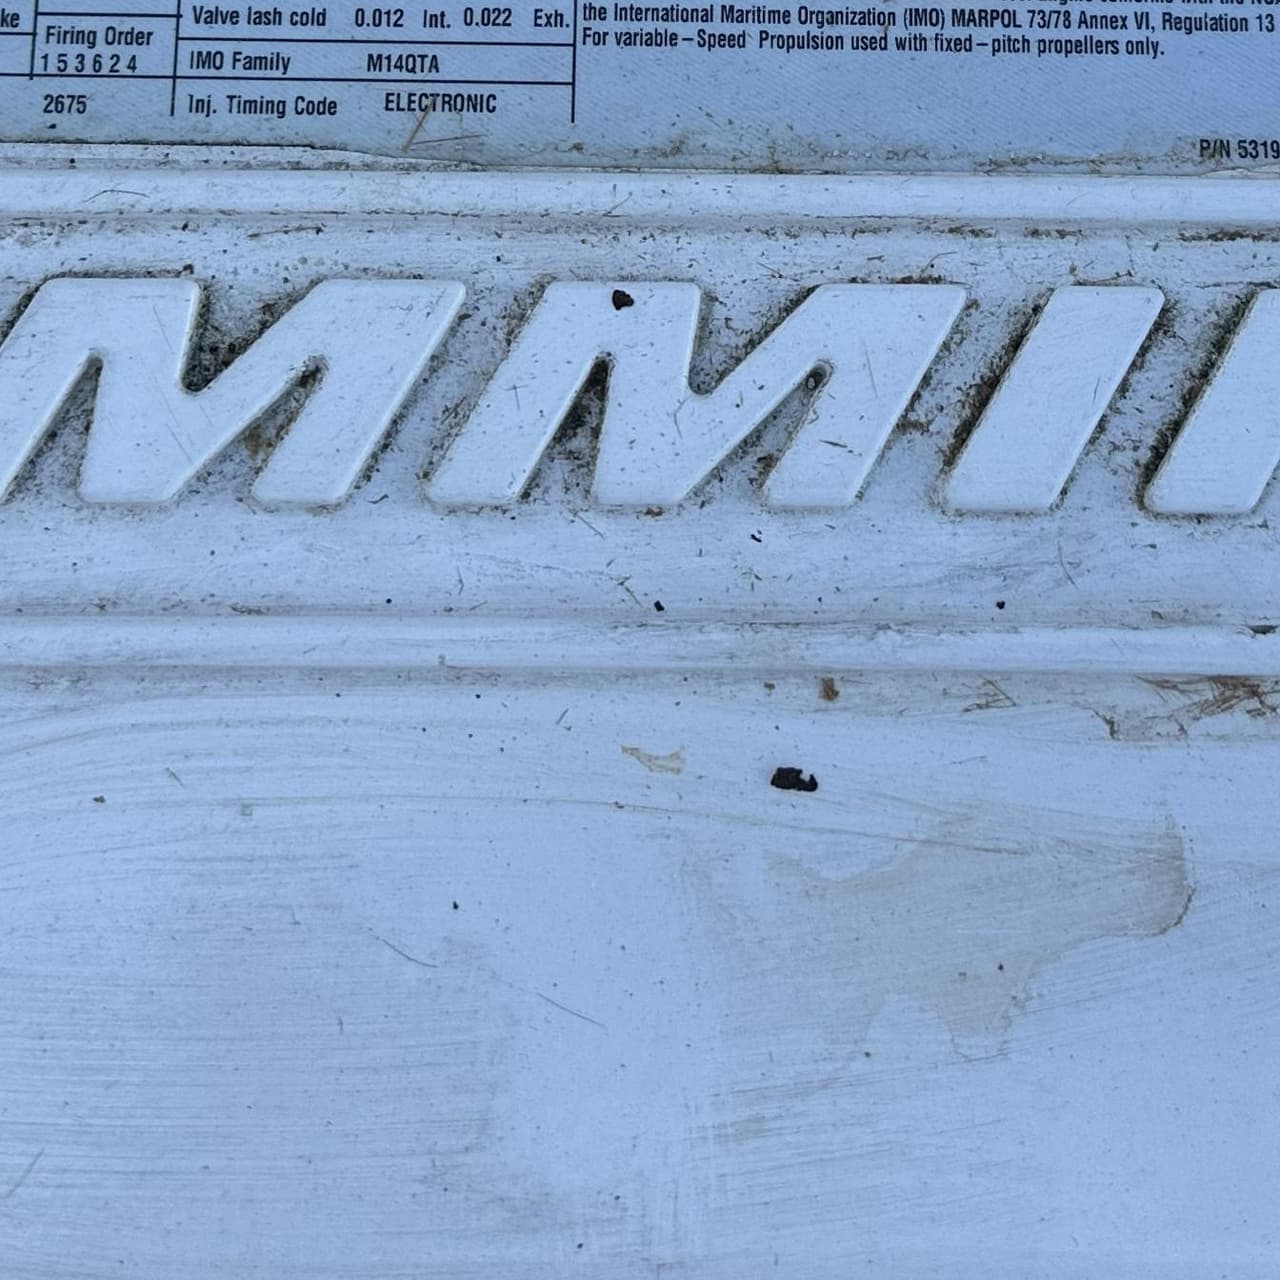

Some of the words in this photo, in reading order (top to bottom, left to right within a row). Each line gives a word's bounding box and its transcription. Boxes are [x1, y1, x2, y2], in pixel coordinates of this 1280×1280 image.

[192, 5, 240, 25] Valve
[247, 6, 282, 26] lash
[290, 7, 327, 27] cold
[355, 8, 404, 28] 0.012
[423, 9, 451, 29] Int.
[464, 7, 512, 27] 0.022
[534, 8, 570, 28] Exh.
[583, 2, 607, 21] the
[614, 3, 714, 23] International
[721, 4, 791, 24] Maritime
[952, 9, 1022, 28] MARPOL
[1027, 9, 1071, 29] 73/78
[1077, 10, 1128, 30] Annex
[1134, 11, 1155, 33] VI,
[1256, 13, 1275, 33] 13
[45, 25, 97, 49] Firing
[104, 26, 154, 46] Order
[190, 50, 224, 71] IMO
[232, 51, 291, 75] Family
[367, 53, 440, 74] M14QTA
[43, 94, 87, 114] 2675
[226, 95, 287, 119] Timing
[294, 96, 337, 116] Code
[384, 92, 497, 114] ELECTRONIC
